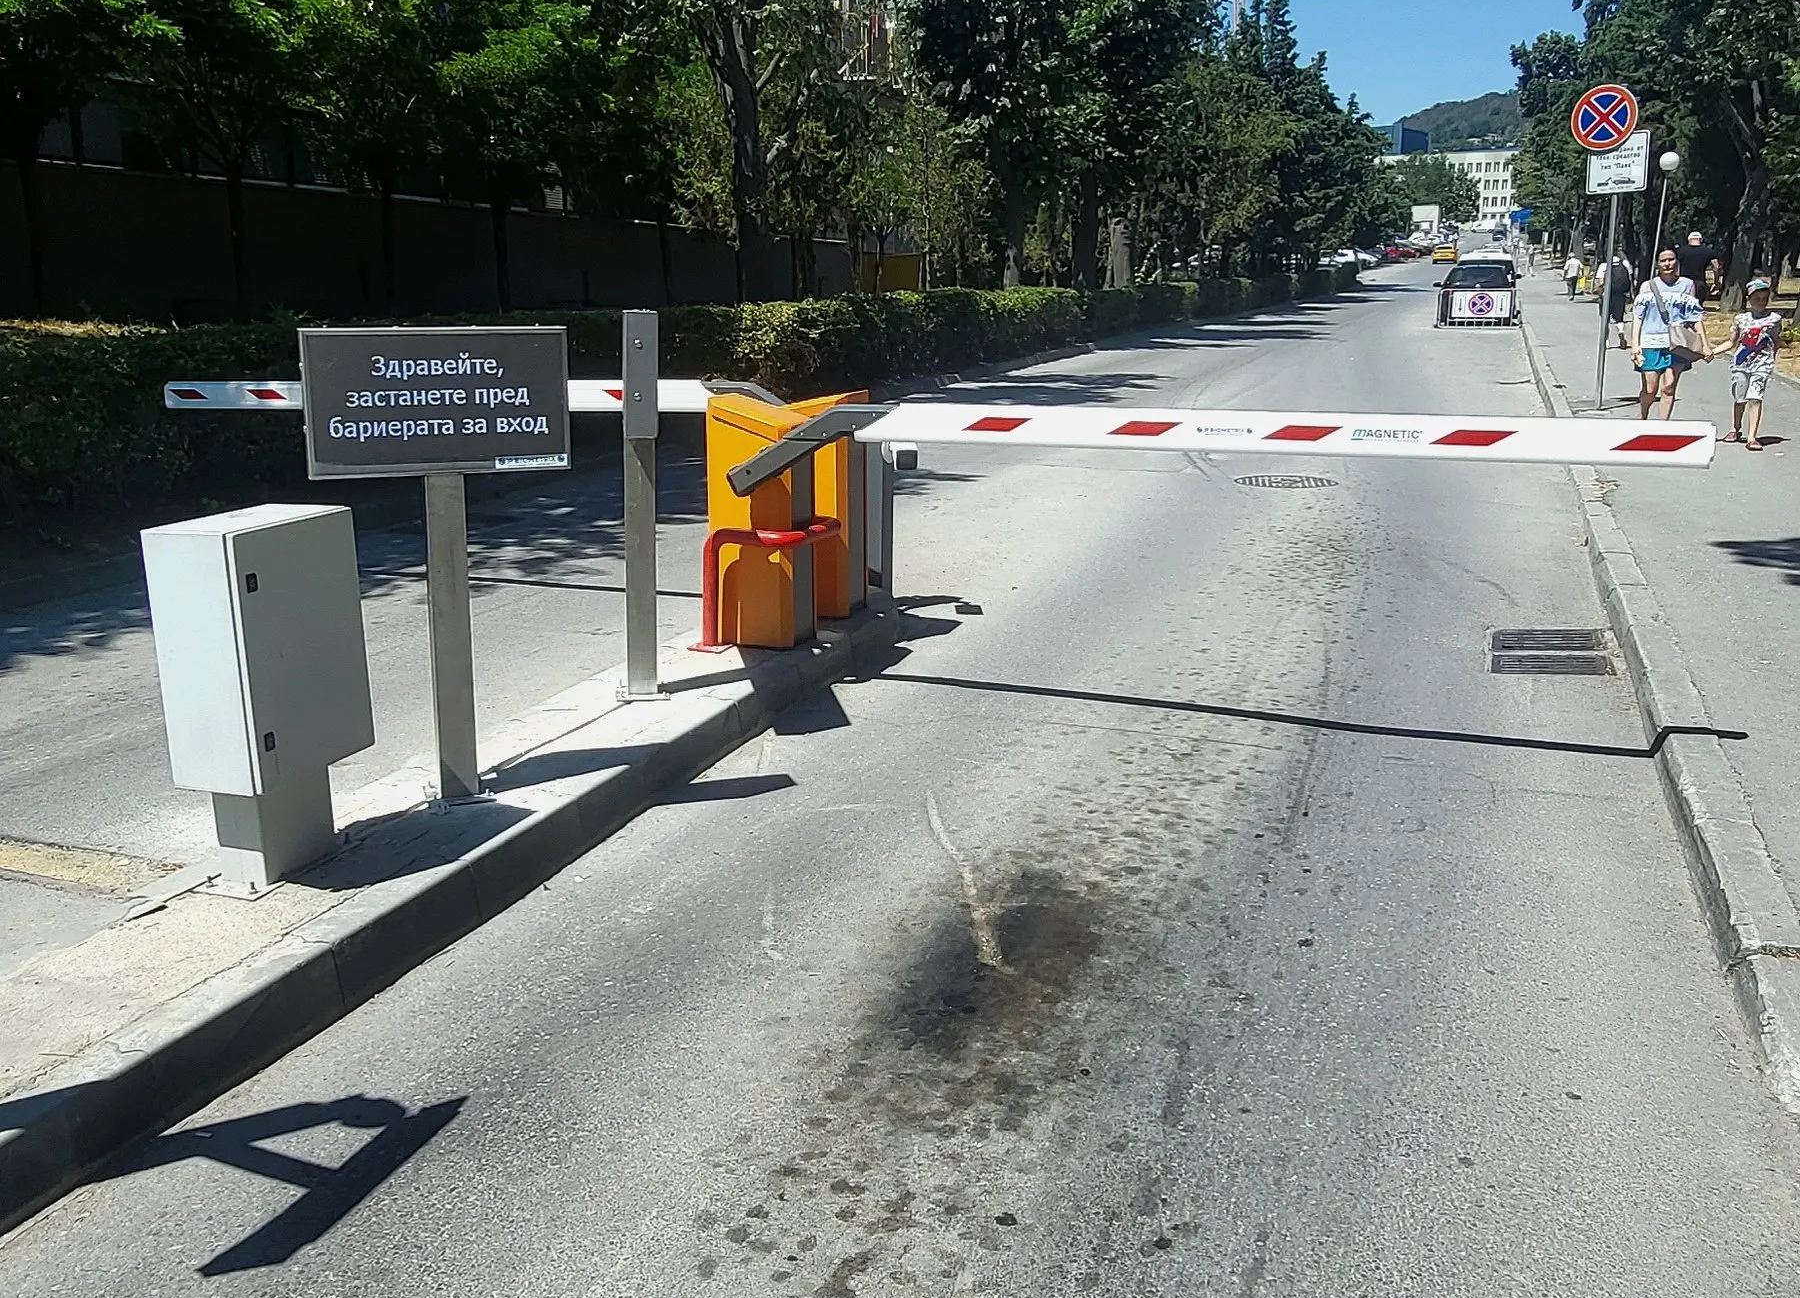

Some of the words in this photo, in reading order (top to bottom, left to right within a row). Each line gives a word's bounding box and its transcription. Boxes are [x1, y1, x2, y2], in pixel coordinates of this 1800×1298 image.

[371, 352, 504, 380] Здравейте,
[345, 389, 466, 407] застанете
[474, 386, 530, 408] пред
[329, 416, 454, 442] бариерата
[461, 418, 487, 434] за
[496, 415, 549, 435] вход
